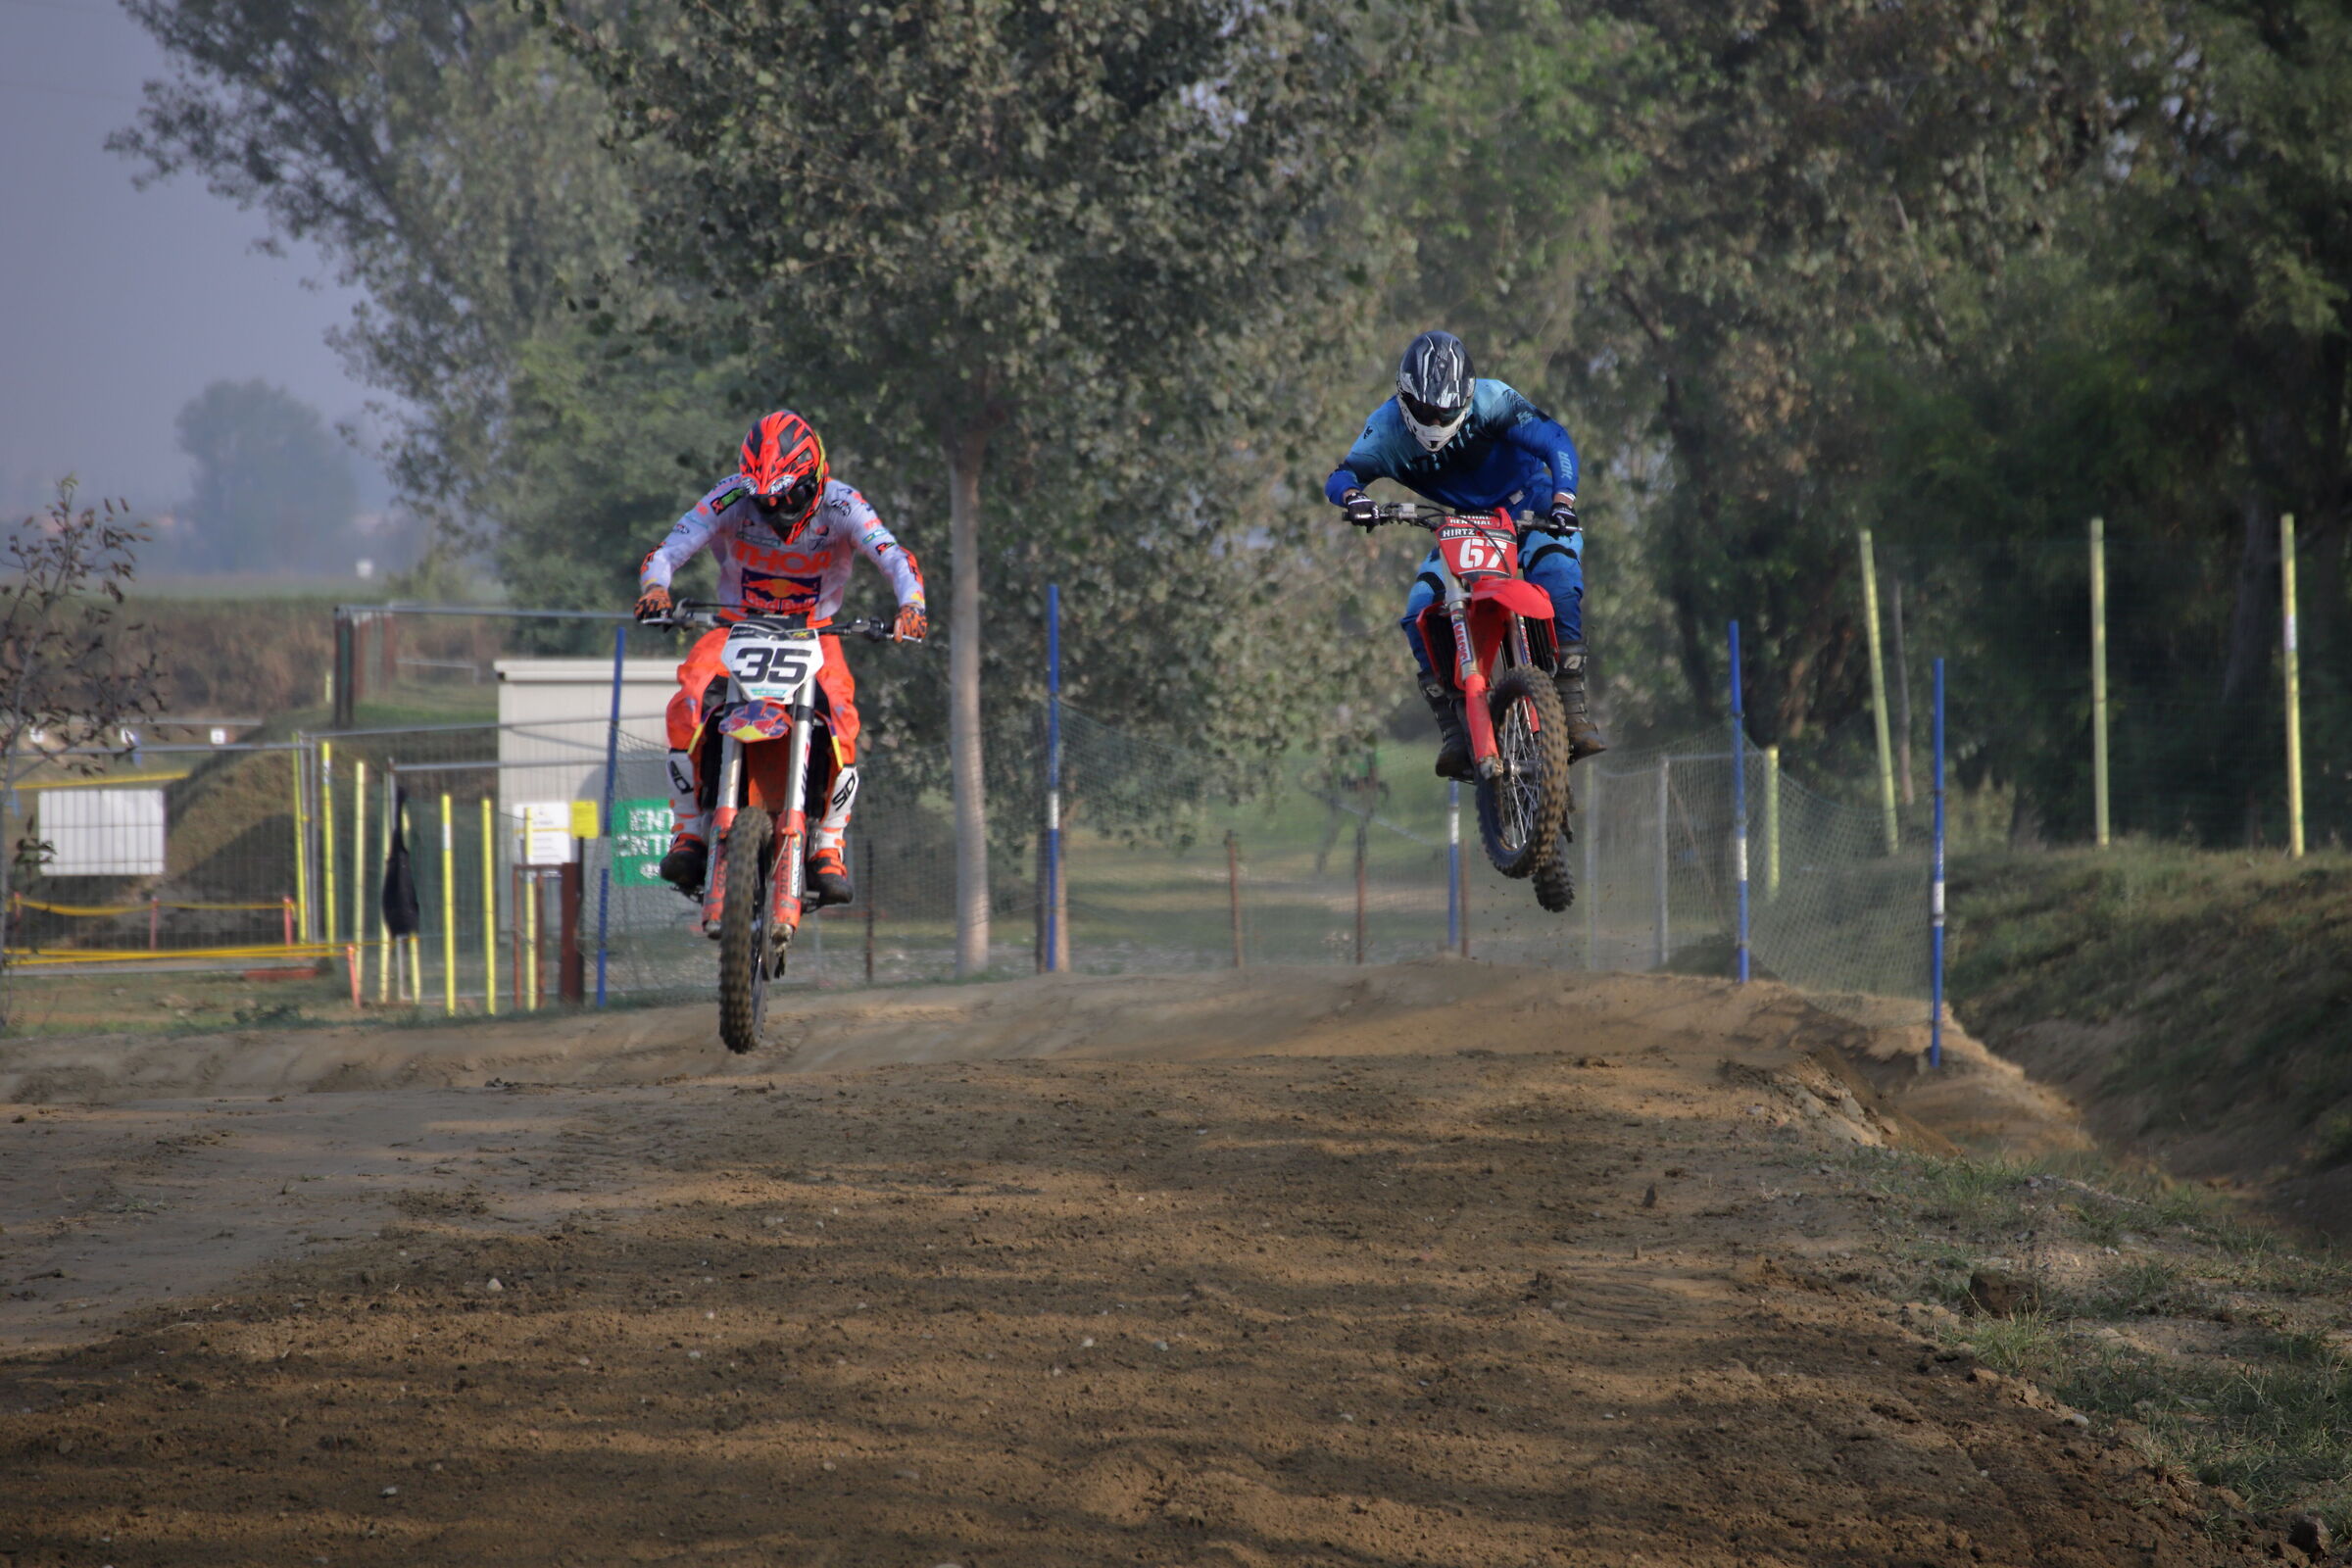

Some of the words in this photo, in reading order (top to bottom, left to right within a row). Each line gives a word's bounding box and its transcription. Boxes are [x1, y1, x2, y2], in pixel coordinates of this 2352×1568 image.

[1443, 528, 1476, 539] HIRTZ
[735, 540, 832, 575] THOR
[1459, 538, 1508, 569] 67
[745, 589, 781, 612] Red
[732, 647, 812, 685] 35
